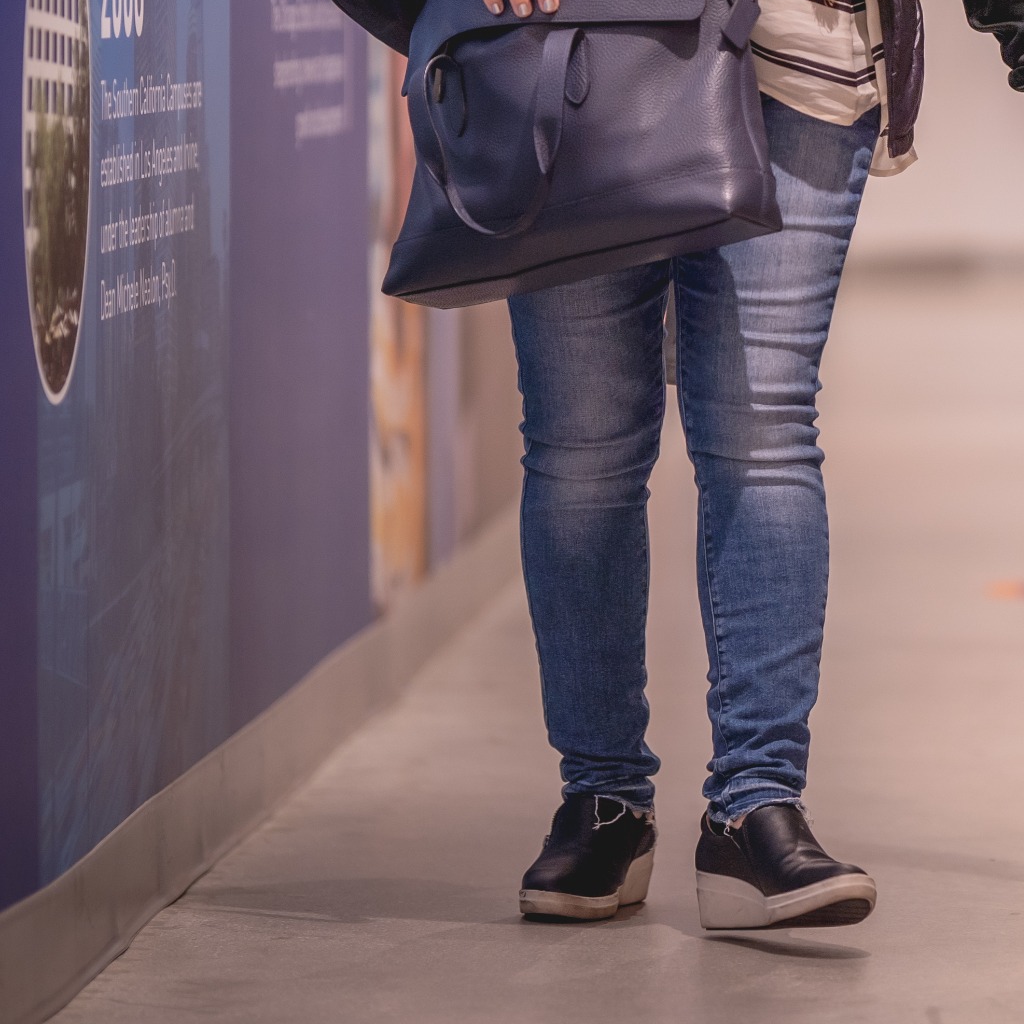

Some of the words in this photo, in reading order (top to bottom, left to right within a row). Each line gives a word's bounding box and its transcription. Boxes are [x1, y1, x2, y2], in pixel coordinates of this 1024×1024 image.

[100, 80, 112, 120] The
[113, 77, 139, 119] Southern
[140, 74, 166, 116] California
[166, 72, 192, 120] Campuses
[193, 81, 202, 108] are
[100, 141, 133, 187] established
[134, 141, 139, 180] in
[140, 140, 151, 179] Los
[152, 137, 173, 187] Angeles
[174, 134, 183, 173] and
[100, 211, 118, 254] under
[119, 208, 128, 248] the
[129, 201, 158, 251] leadership
[159, 199, 165, 238] of
[184, 195, 194, 231] and
[100, 279, 116, 321] Dean
[116, 270, 139, 315] Michele
